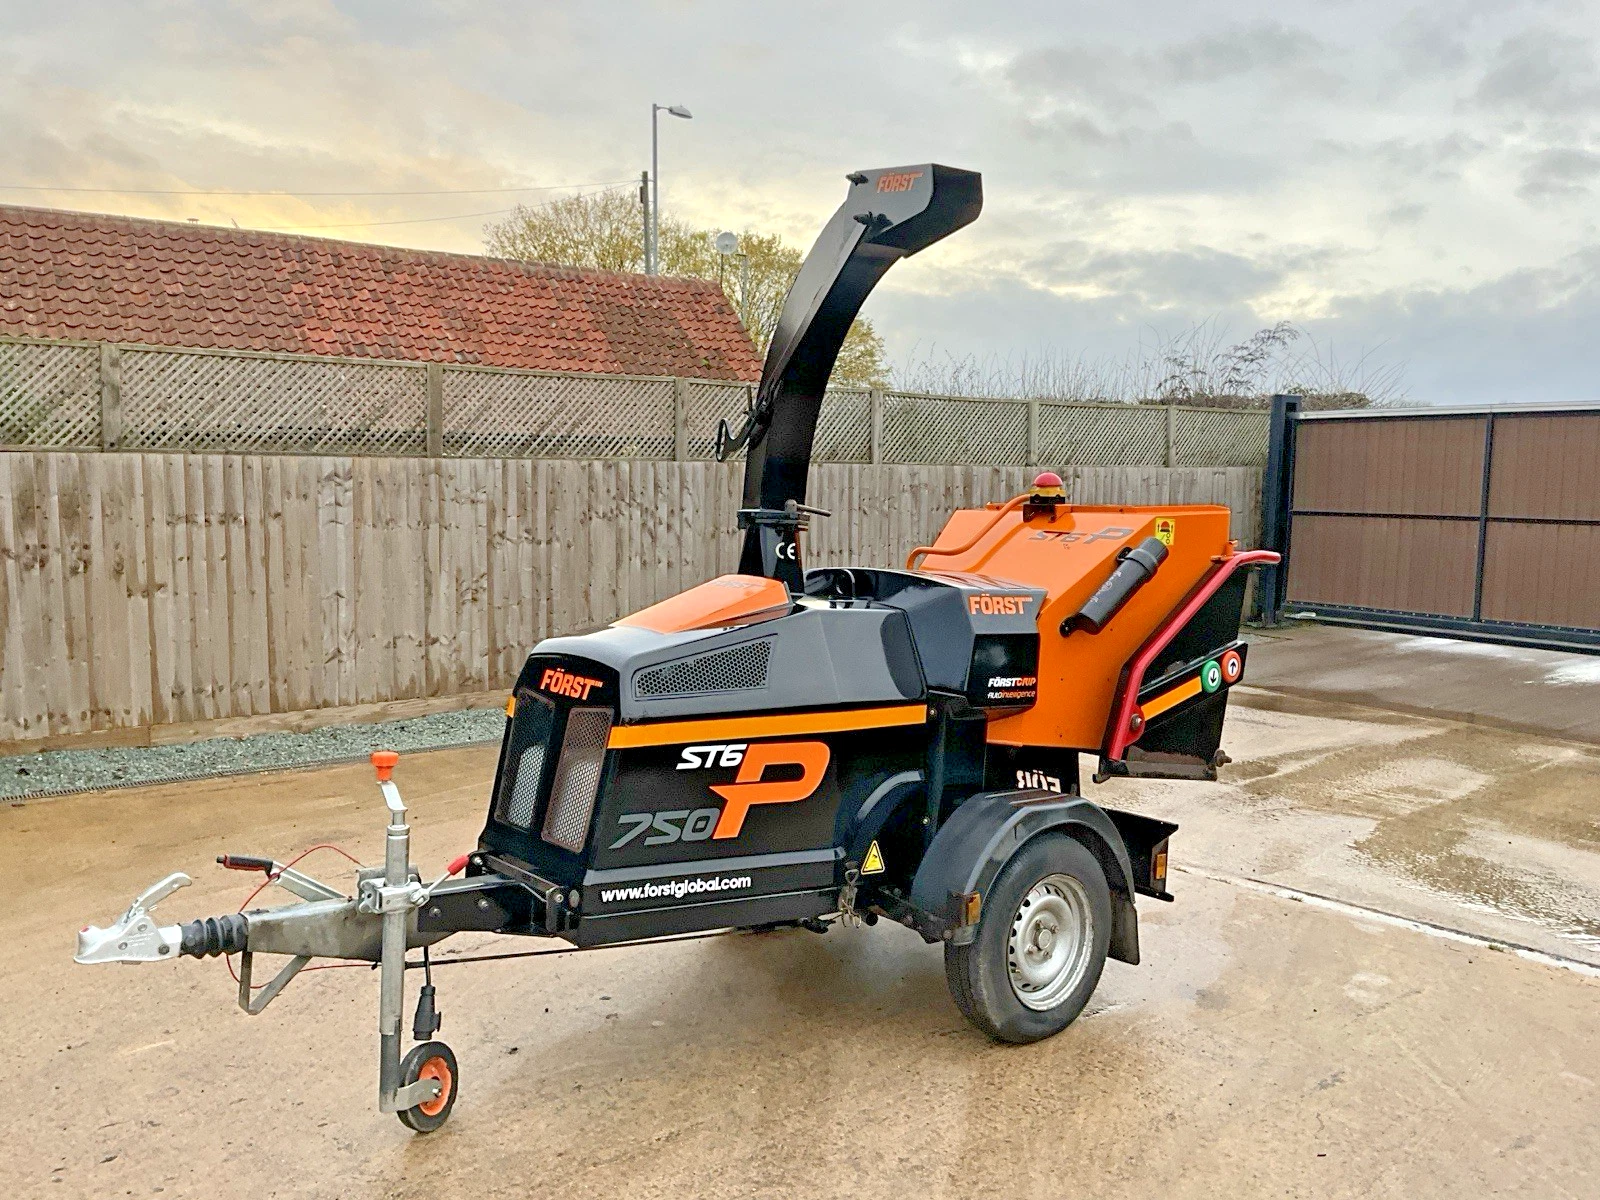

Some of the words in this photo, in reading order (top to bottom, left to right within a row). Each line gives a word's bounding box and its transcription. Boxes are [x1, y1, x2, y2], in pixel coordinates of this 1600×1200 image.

[877, 172, 923, 193] FÖRST
[775, 541, 796, 559] CE
[969, 593, 1033, 615] FÖRST
[540, 667, 603, 700] FÖRST
[608, 807, 720, 850] 750
[601, 876, 752, 903] www.forstglobal.com
